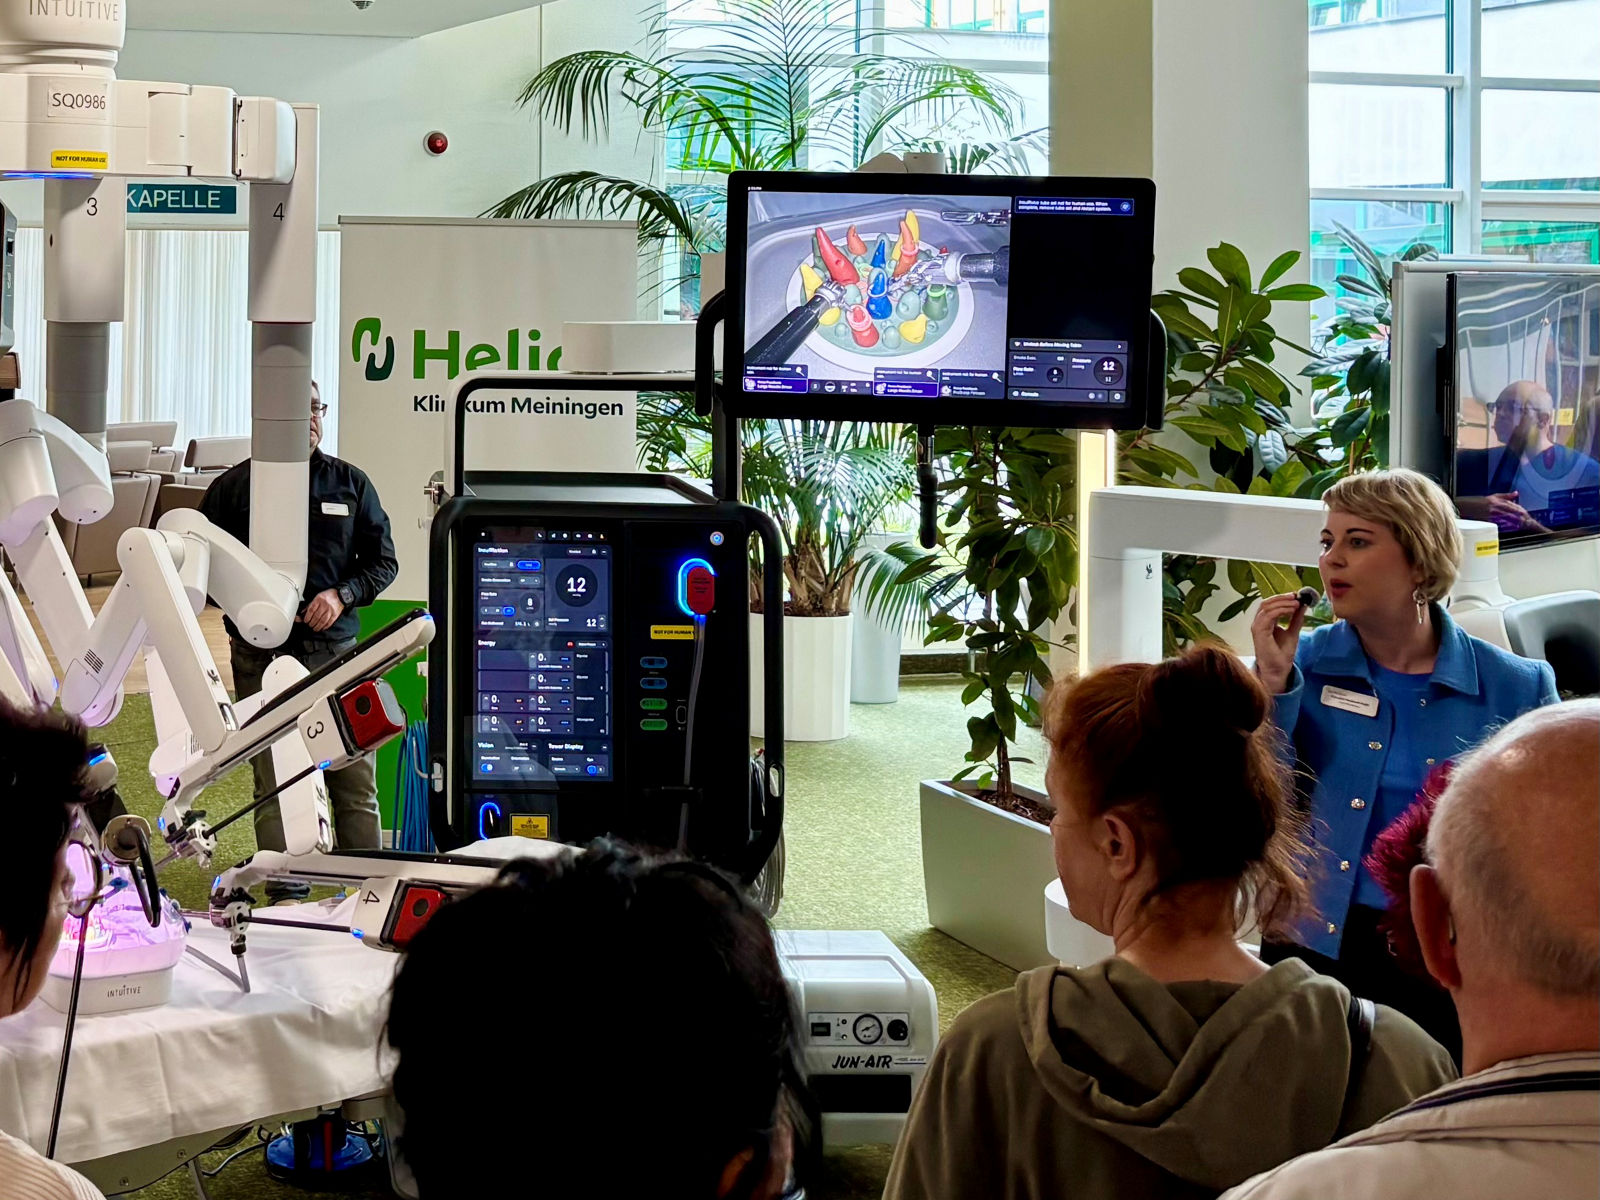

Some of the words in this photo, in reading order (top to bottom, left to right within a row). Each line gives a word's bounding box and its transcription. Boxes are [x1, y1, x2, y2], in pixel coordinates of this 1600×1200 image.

[29, 0, 119, 21] INTUITIVE
[52, 92, 106, 110] SQ0986
[126, 189, 220, 208] KAPELLE
[86, 198, 98, 216] 3
[273, 203, 285, 221] 4
[1103, 361, 1115, 371] 12
[414, 394, 504, 413] Klikum
[512, 397, 623, 419] Meiningen
[567, 577, 586, 593] 12
[527, 598, 533, 606] 8
[586, 619, 596, 627] 12
[538, 653, 544, 661] 0
[538, 674, 544, 682] 0
[491, 695, 497, 703] 0
[538, 695, 544, 704] 0
[491, 716, 497, 724] 0
[538, 717, 544, 725] 0
[306, 720, 324, 740] 3
[362, 890, 380, 904] 4
[832, 1054, 892, 1069] JUN-AIR
